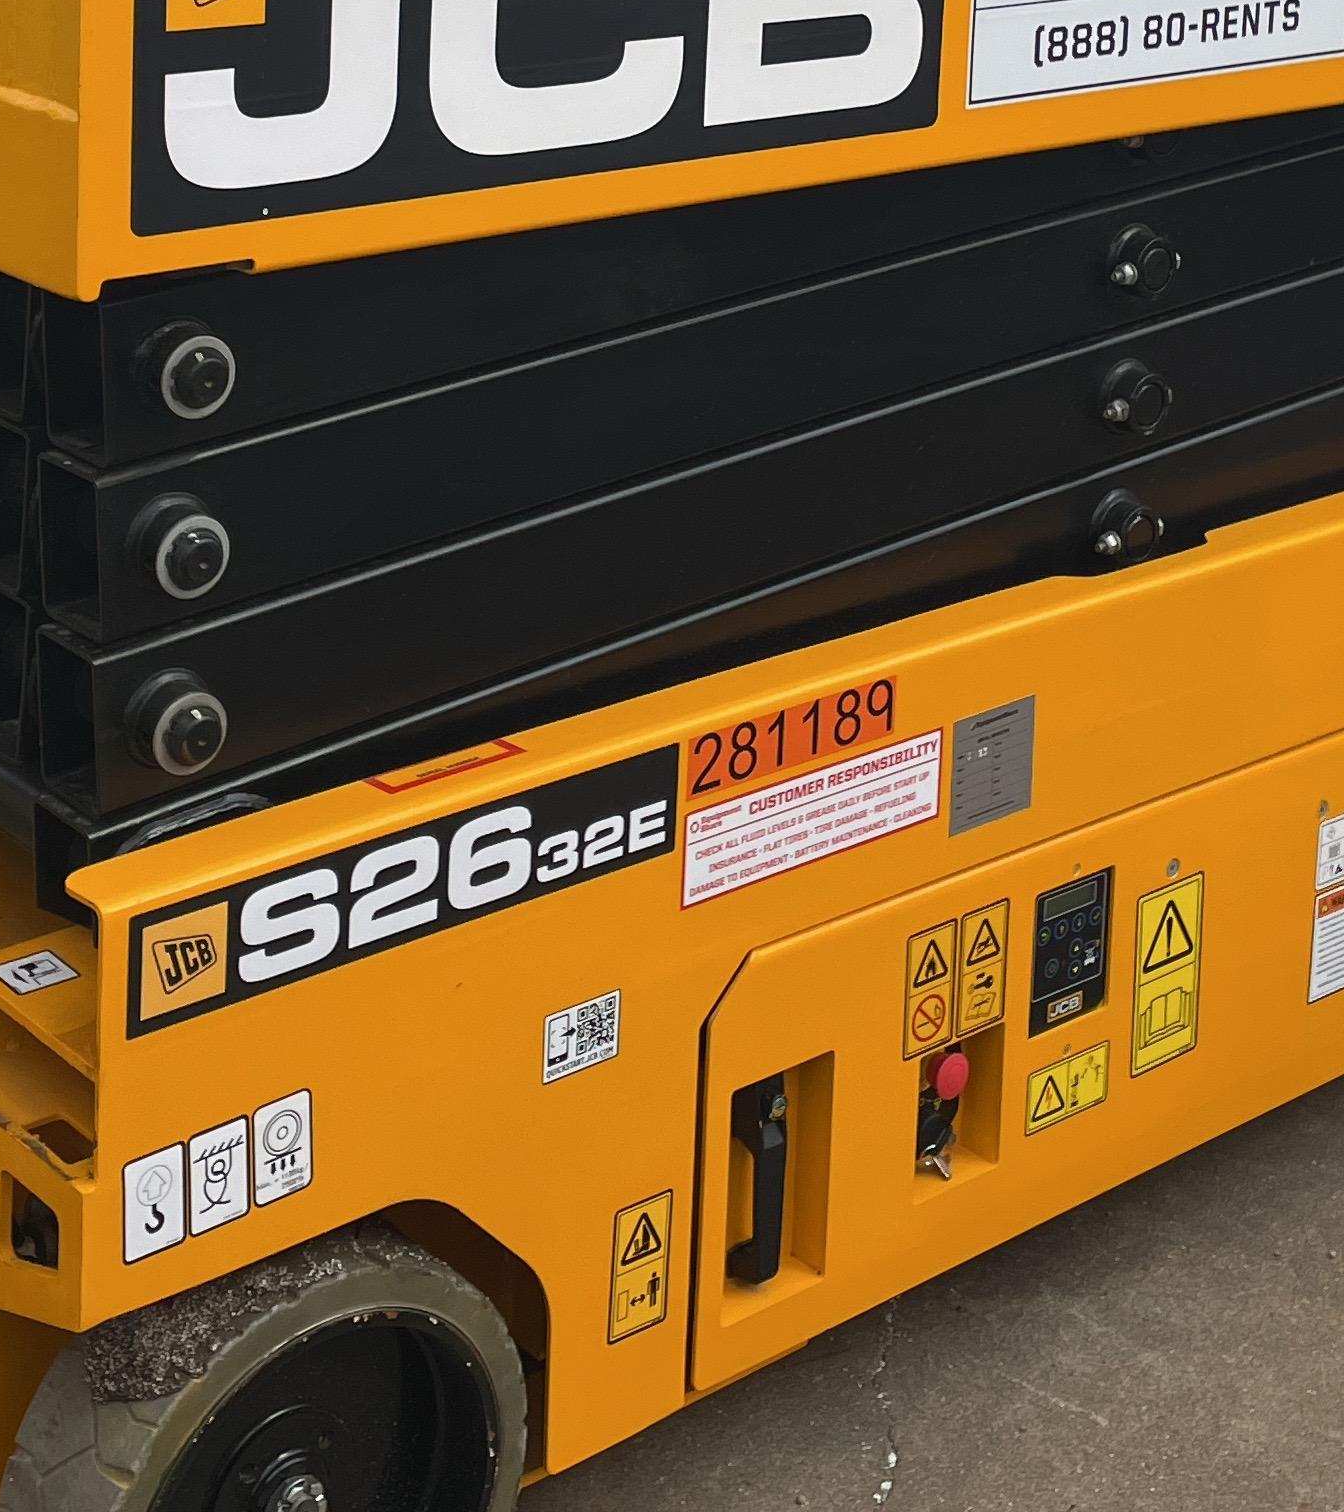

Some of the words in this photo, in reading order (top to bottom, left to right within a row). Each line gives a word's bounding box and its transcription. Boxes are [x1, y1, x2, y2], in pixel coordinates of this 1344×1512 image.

[1033, 15, 1130, 68] (888)
[690, 678, 896, 796] 281189
[748, 777, 825, 815] CUSTOMER
[828, 739, 939, 789] RESPONSIBILITY
[768, 817, 797, 835] LEVELS
[164, 933, 213, 987] JCB
[1049, 996, 1080, 1018] JCB
